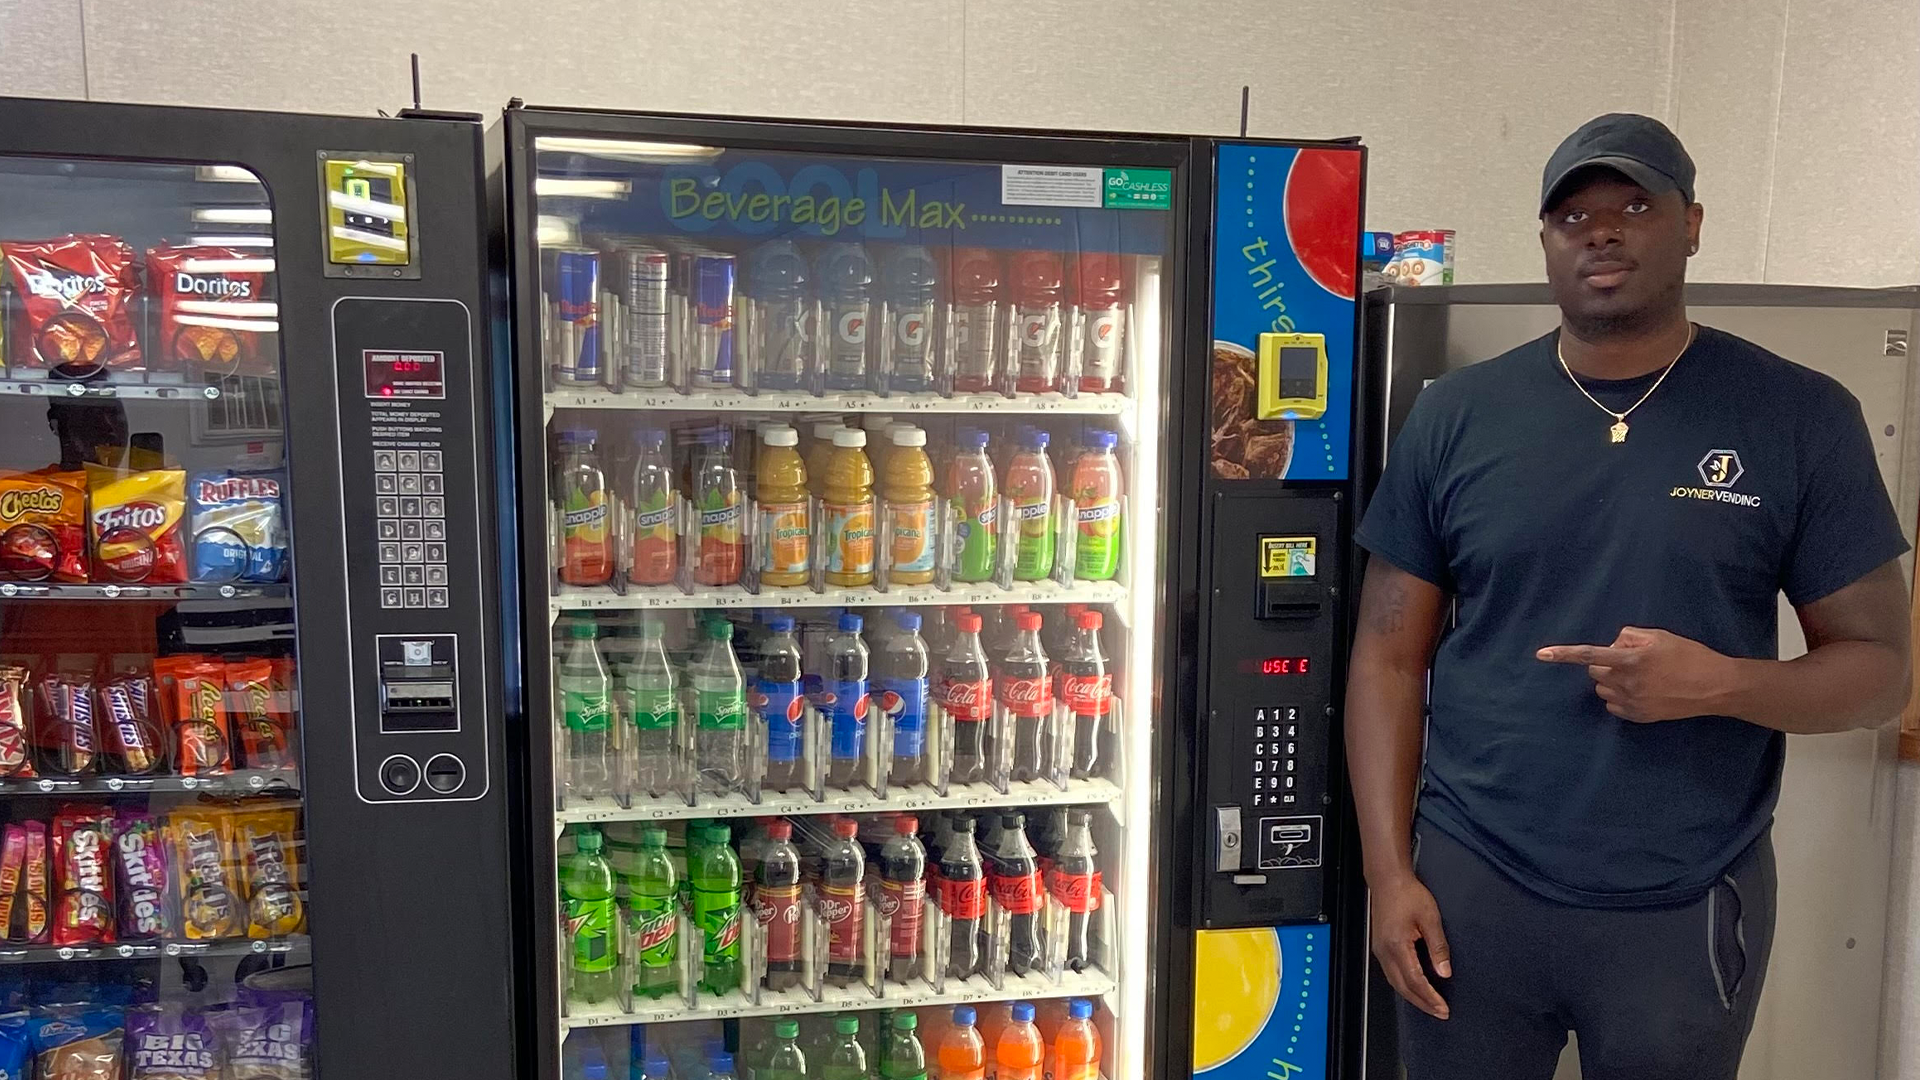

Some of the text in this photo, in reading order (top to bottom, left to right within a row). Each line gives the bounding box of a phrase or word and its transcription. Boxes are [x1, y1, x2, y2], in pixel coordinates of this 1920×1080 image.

[1108, 177, 1168, 192] GO CASHLESS
[670, 178, 866, 235] Beverage
[881, 188, 966, 230] Max
[176, 272, 251, 297] Doritos
[1243, 237, 1296, 333] thirs
[575, 397, 586, 405] A1
[644, 398, 656, 406] A2
[712, 399, 724, 407] A3
[778, 400, 790, 408] A4
[972, 402, 983, 410] A7
[1711, 454, 1734, 482] J
[200, 478, 280, 503] RUFFLES
[2, 488, 62, 518] Cheetos
[94, 505, 167, 531] Fritos
[776, 527, 808, 540] Tropican
[223, 548, 263, 562] ORIGIAL
[649, 598, 660, 606] B2
[781, 597, 792, 605] B4
[908, 595, 919, 603] B6
[1263, 659, 1309, 673] USE E
[200, 680, 222, 742] Reese's
[1256, 708, 1296, 721] A 1 2
[1256, 725, 1295, 737] B 3 4
[1256, 742, 1295, 755] C 5 6
[1255, 760, 1294, 772] D 7 8
[1255, 776, 1294, 789] E 9 0
[905, 800, 917, 808] C6
[1254, 794, 1262, 806] F
[717, 808, 729, 816] C3
[780, 805, 792, 813] C4
[844, 803, 855, 811] C5
[586, 813, 597, 821] C1
[652, 810, 664, 818] C2
[72, 829, 105, 922] Skittles
[827, 899, 841, 910] Dr
[653, 1013, 665, 1021] D2
[717, 1009, 728, 1017] D3
[588, 1017, 599, 1025] D1
[141, 1033, 204, 1051] BIG
[136, 1050, 214, 1069] TEXAS
